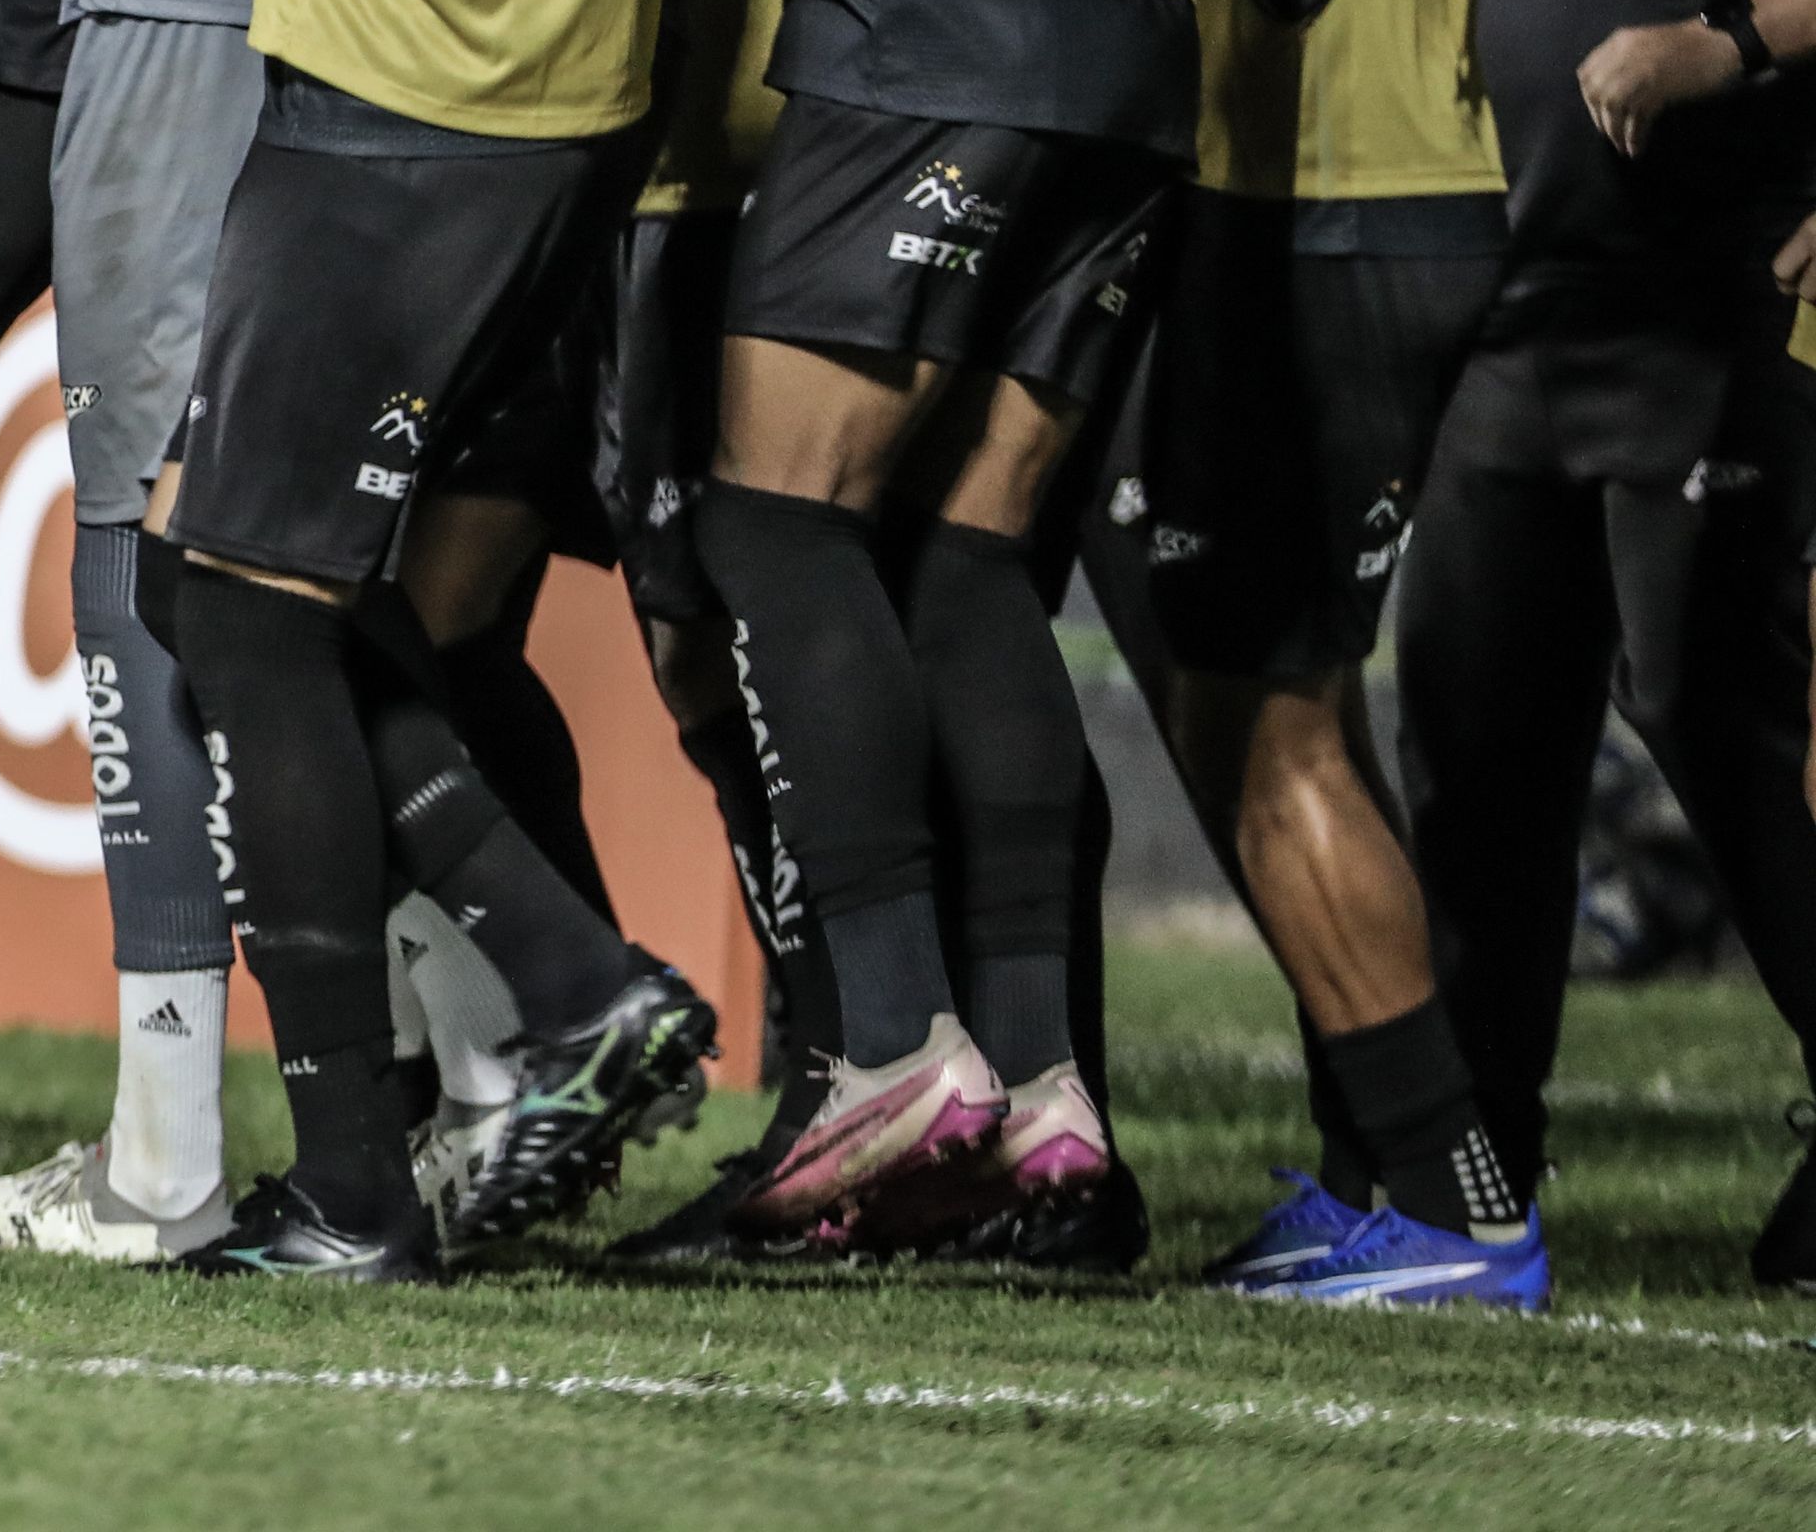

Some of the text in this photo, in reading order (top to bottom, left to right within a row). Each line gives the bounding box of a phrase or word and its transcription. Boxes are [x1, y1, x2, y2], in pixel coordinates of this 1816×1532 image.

[354, 461, 419, 501] BE
[81, 654, 141, 826] TODOS
[138, 1017, 193, 1039] adidas
